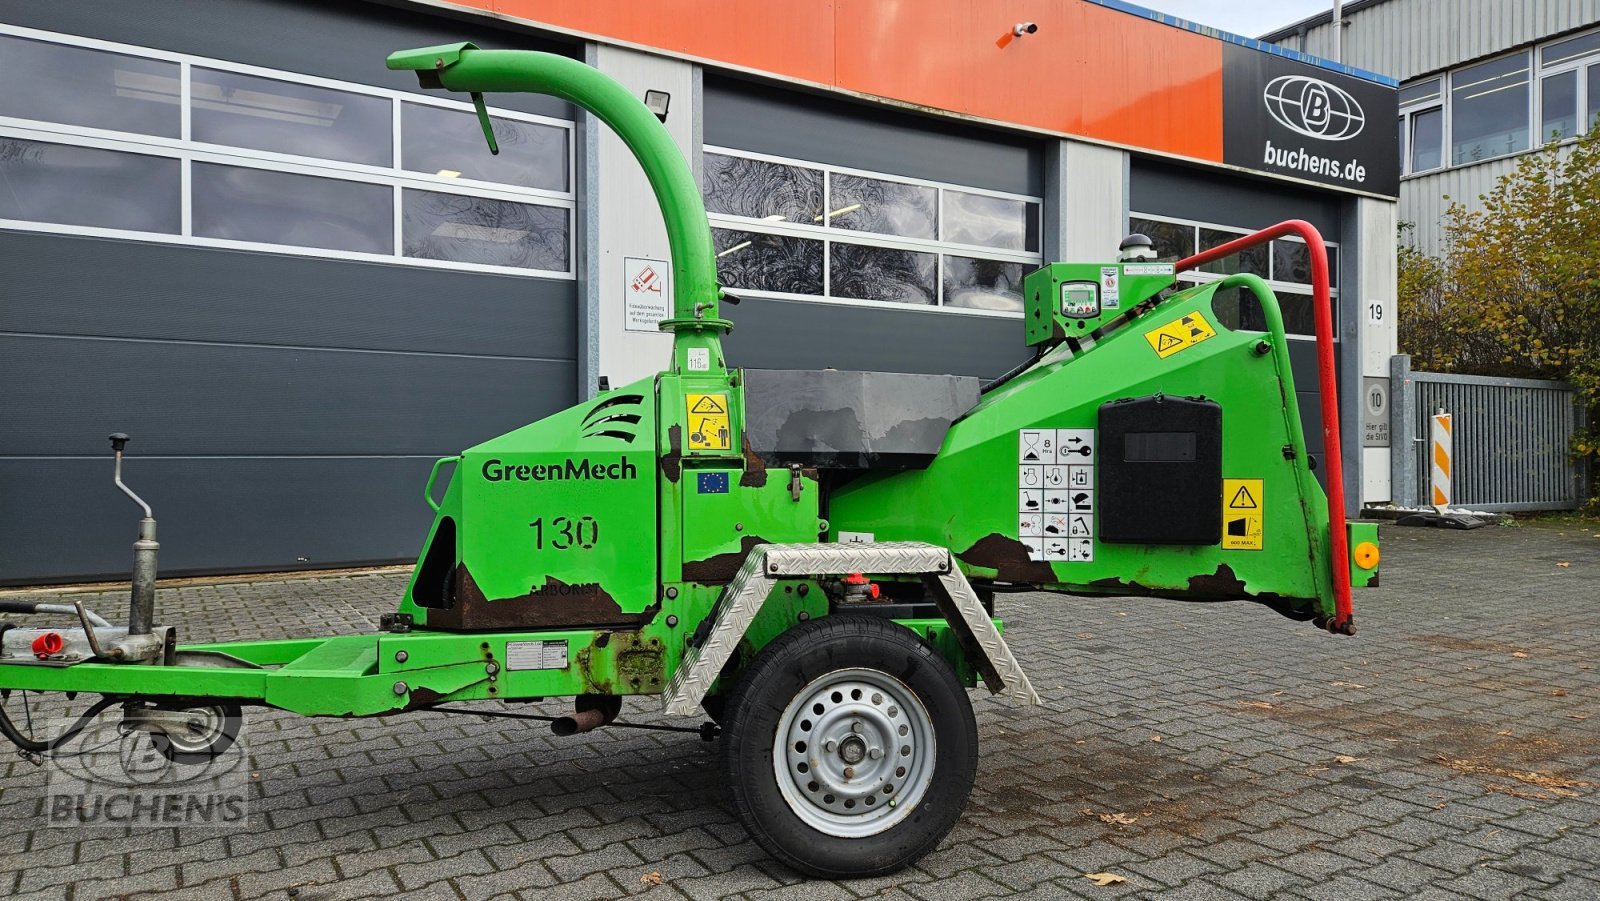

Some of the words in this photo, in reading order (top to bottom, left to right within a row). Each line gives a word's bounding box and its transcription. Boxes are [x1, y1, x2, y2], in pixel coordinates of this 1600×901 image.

[1264, 140, 1366, 182] buchens.de
[1369, 303, 1383, 320] 19
[689, 357, 702, 369] 116
[1371, 393, 1382, 408] 10
[1366, 422, 1377, 430] Hier
[1044, 439, 1051, 448] 8
[1366, 432, 1374, 440] die
[1375, 432, 1388, 441] StVO
[482, 455, 637, 481] GreenMech
[529, 516, 599, 550] 130
